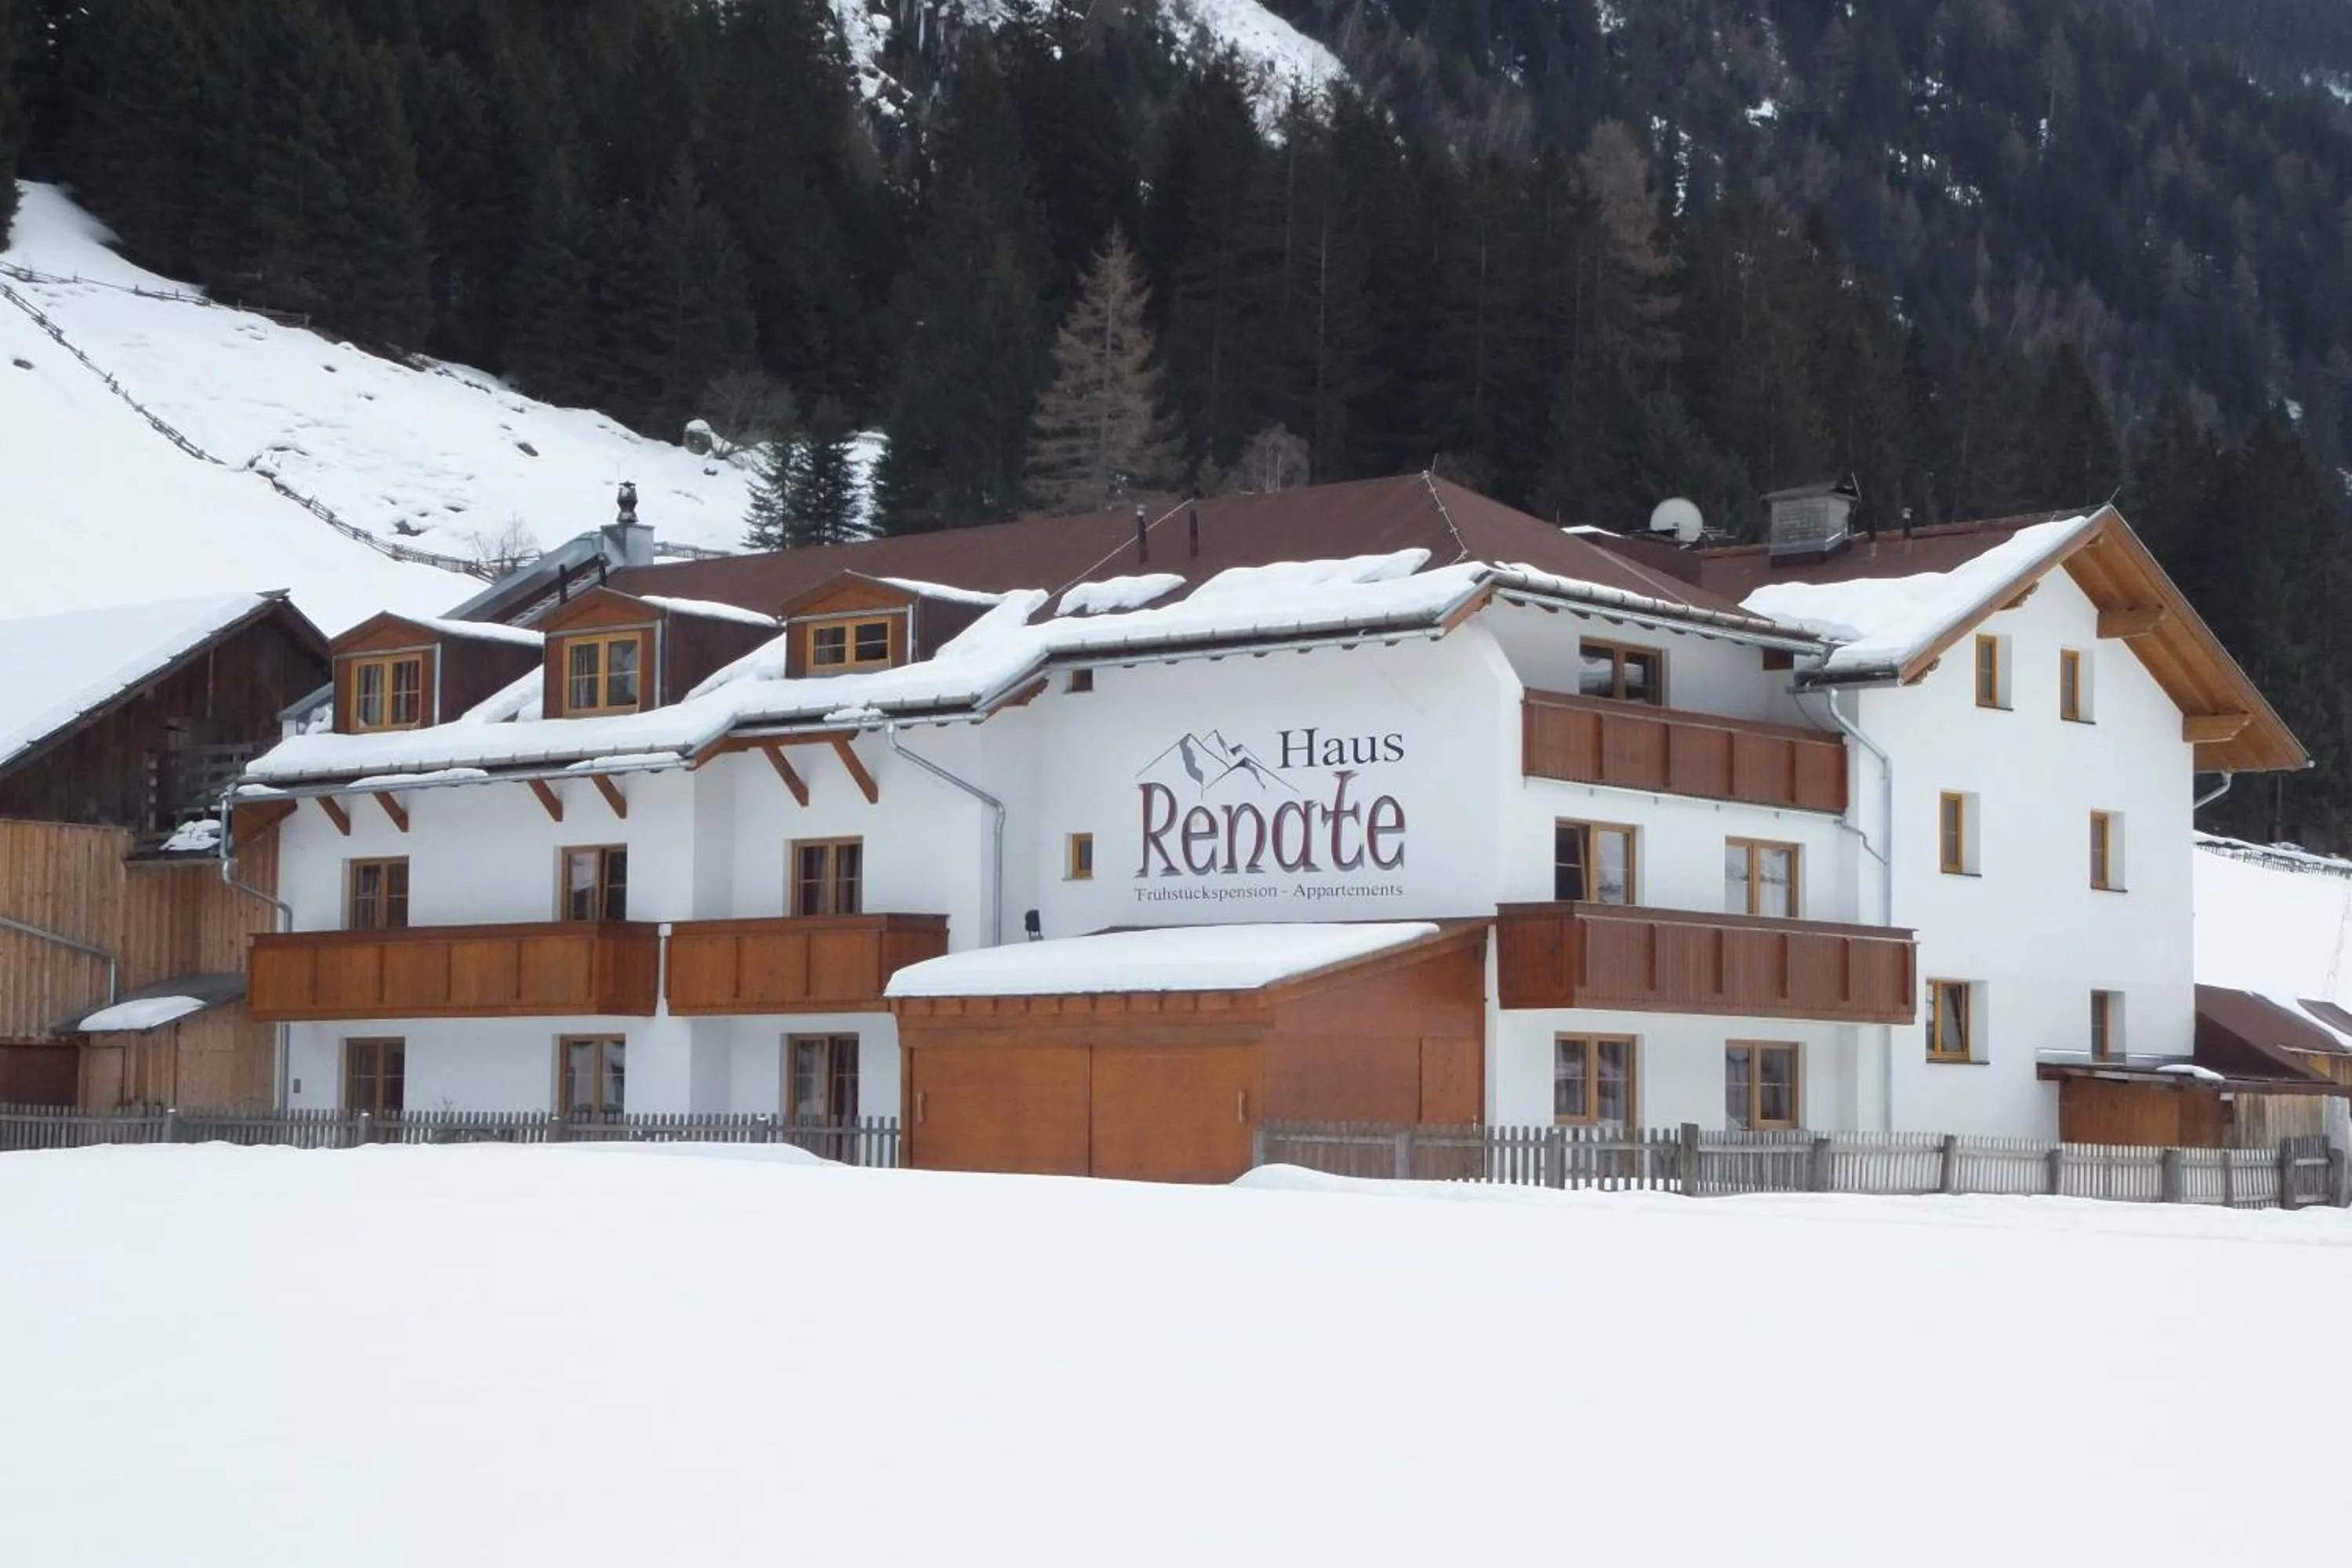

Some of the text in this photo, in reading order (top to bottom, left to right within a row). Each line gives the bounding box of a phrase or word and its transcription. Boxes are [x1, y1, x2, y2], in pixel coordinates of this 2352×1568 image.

[1277, 728, 1405, 768] Haus
[1134, 770, 1406, 877] Renate
[1293, 884, 1403, 899] Appartements
